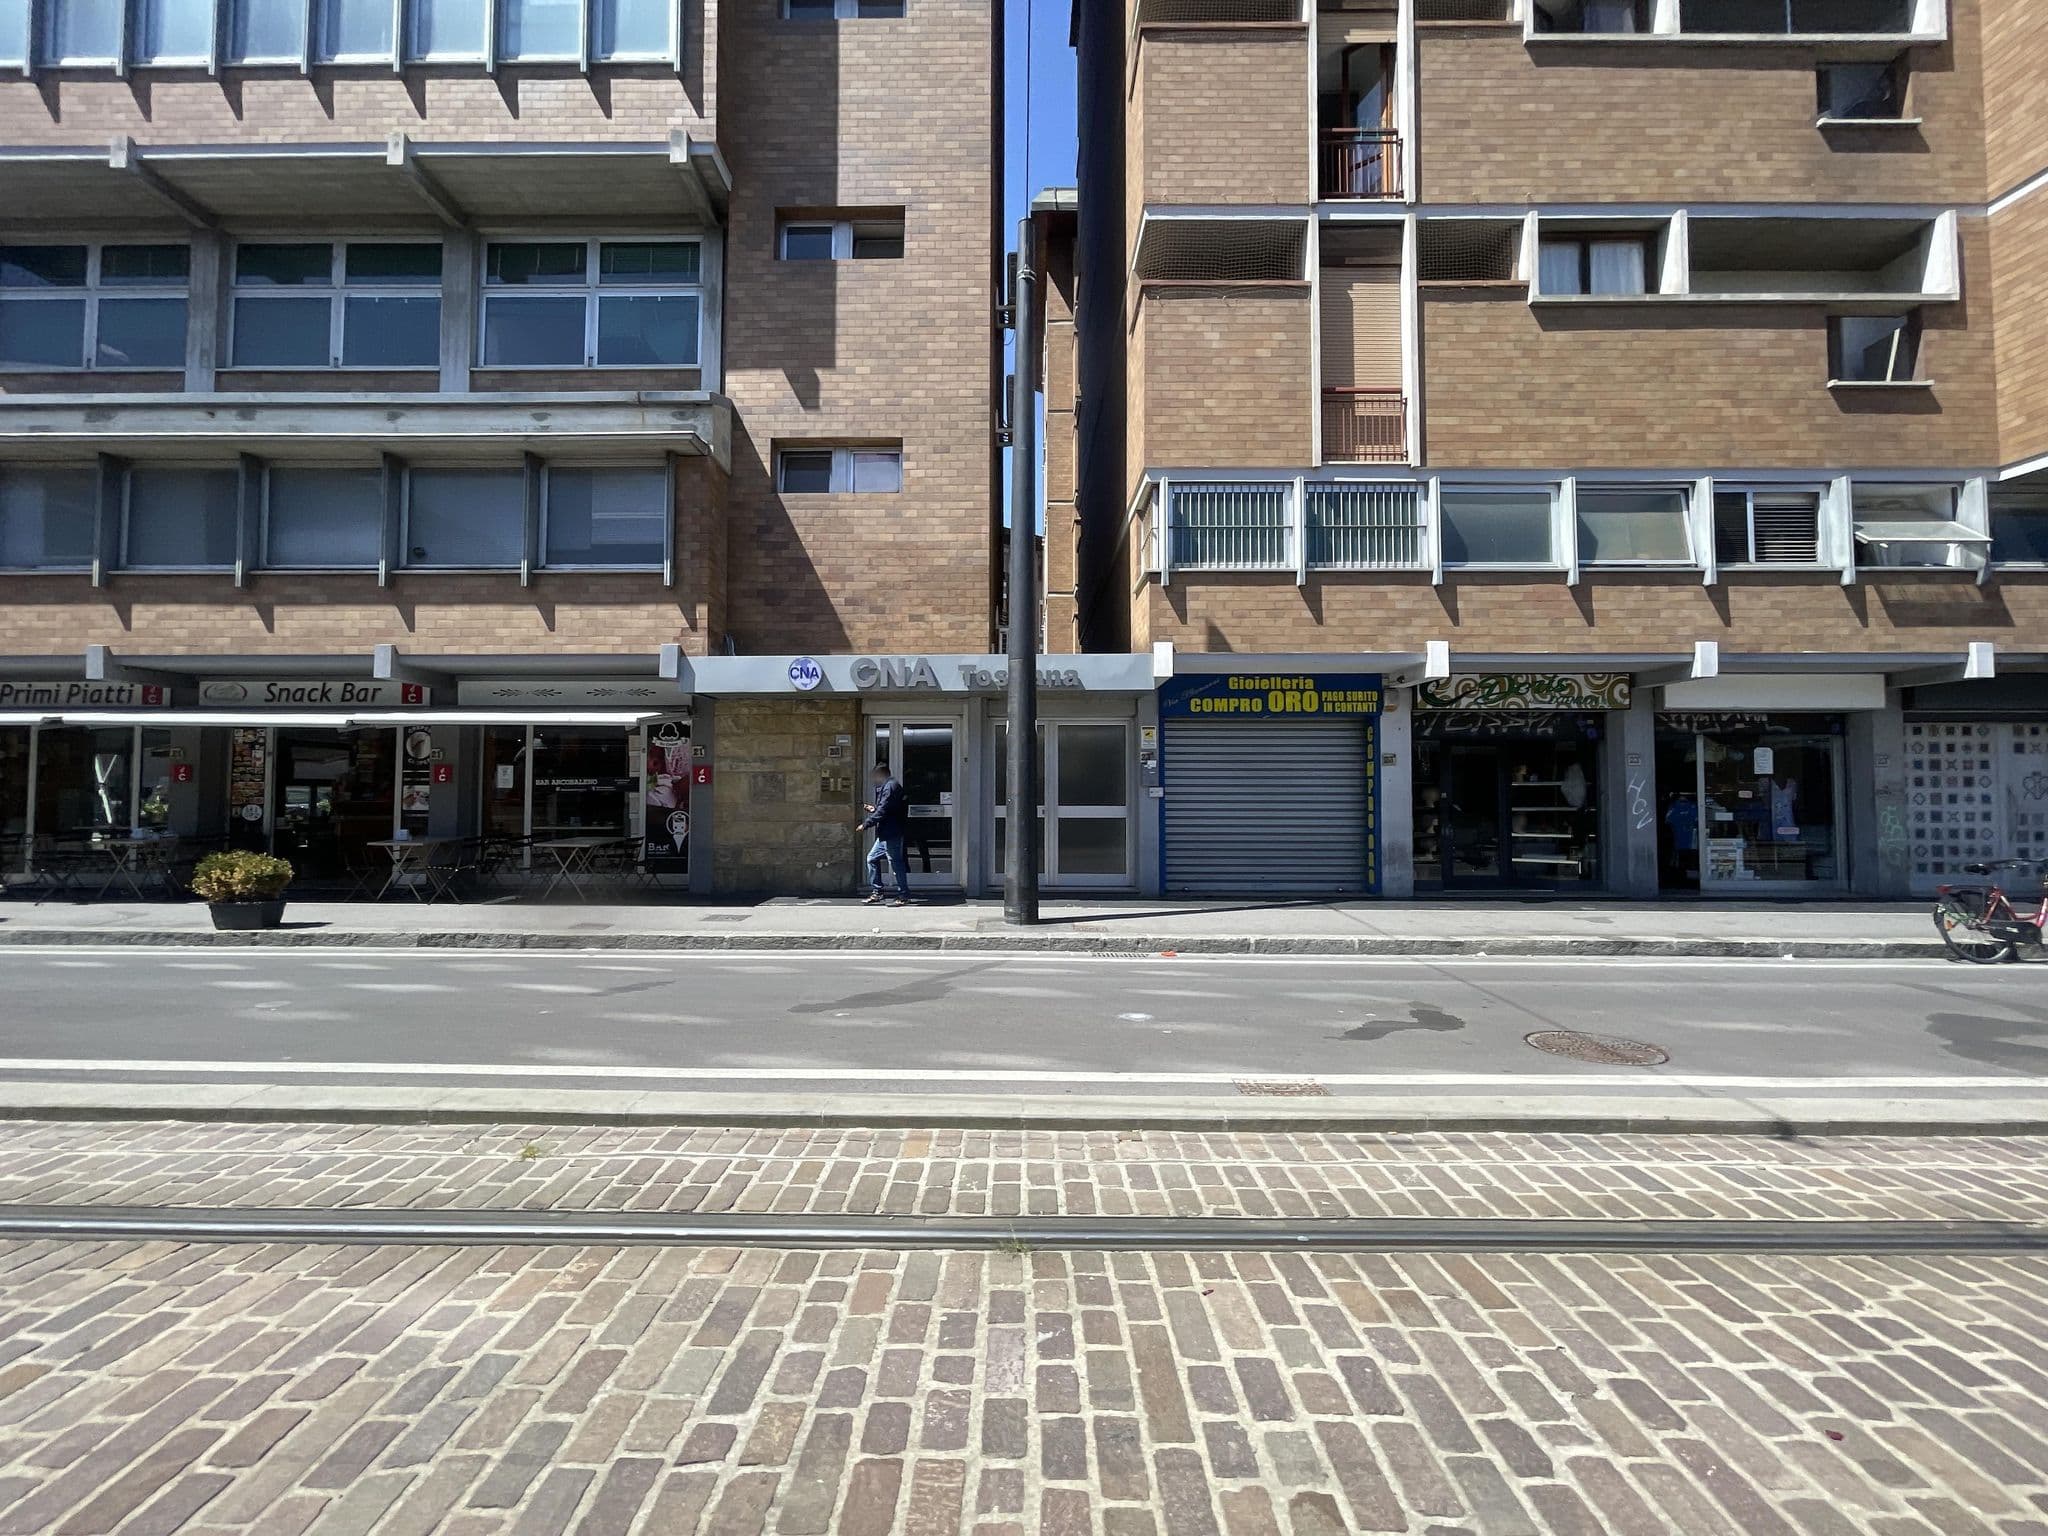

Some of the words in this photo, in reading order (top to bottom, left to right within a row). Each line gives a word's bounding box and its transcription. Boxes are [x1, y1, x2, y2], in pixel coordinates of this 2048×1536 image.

[789, 666, 820, 680] CNA
[850, 656, 938, 689] CNA
[264, 682, 333, 703] Snack
[340, 682, 382, 703] Bar
[1228, 676, 1315, 691] Gioielleria
[0, 682, 61, 705] Primi
[66, 683, 134, 705] Piatti
[1189, 697, 1263, 713] COMPRO
[1267, 690, 1319, 713] ORO
[1321, 690, 1344, 702] PAGO
[1345, 690, 1379, 702] SUBITO
[1323, 702, 1333, 713] IN
[1334, 702, 1378, 713] CONTANTI
